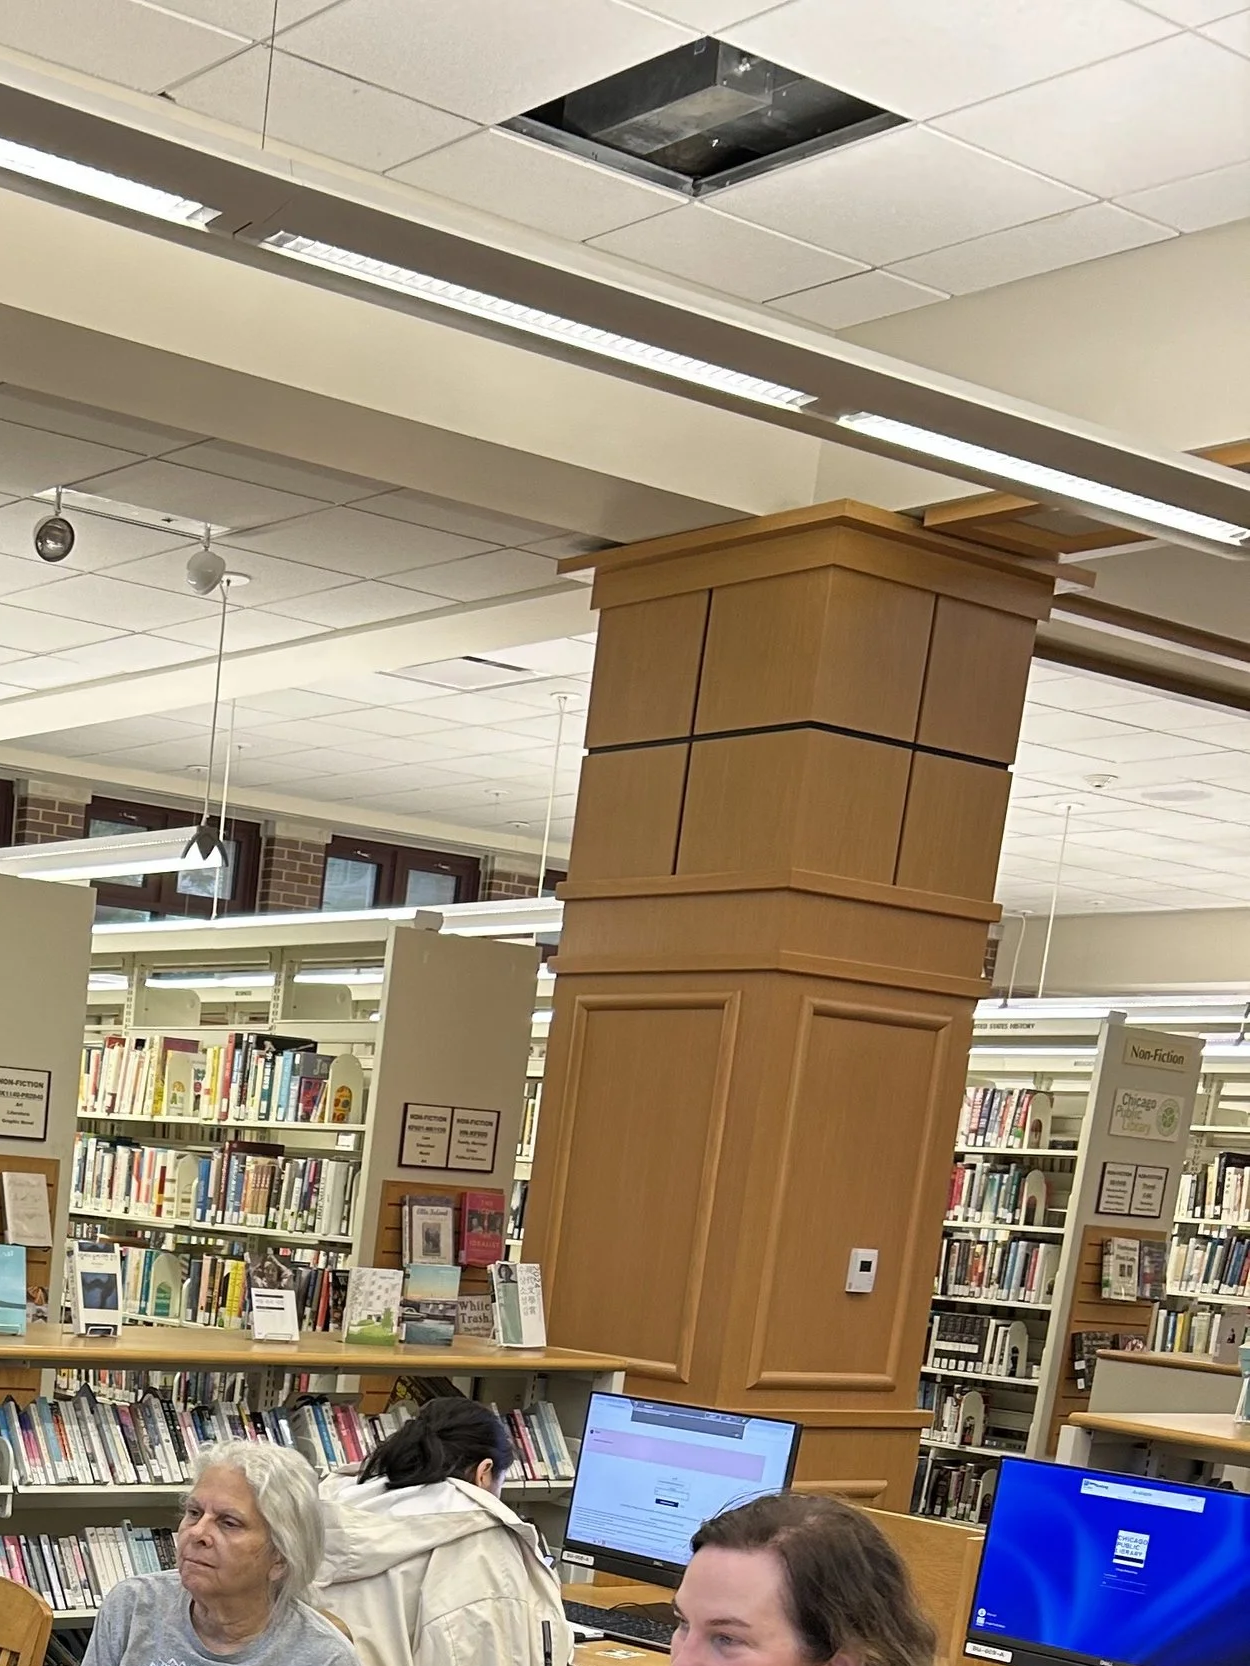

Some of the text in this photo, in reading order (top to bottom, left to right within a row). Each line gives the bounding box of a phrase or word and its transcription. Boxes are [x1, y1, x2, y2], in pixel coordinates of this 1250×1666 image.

[1130, 1044, 1185, 1065] Non-Fiction
[1122, 1092, 1157, 1112] Chicago
[430, 1209, 449, 1217] Island
[459, 1301, 490, 1311] White
[1117, 1535, 1149, 1546] CHICAGO
[1116, 1542, 1141, 1551] PUBLIC
[1115, 1549, 1143, 1557] LIBRARY
